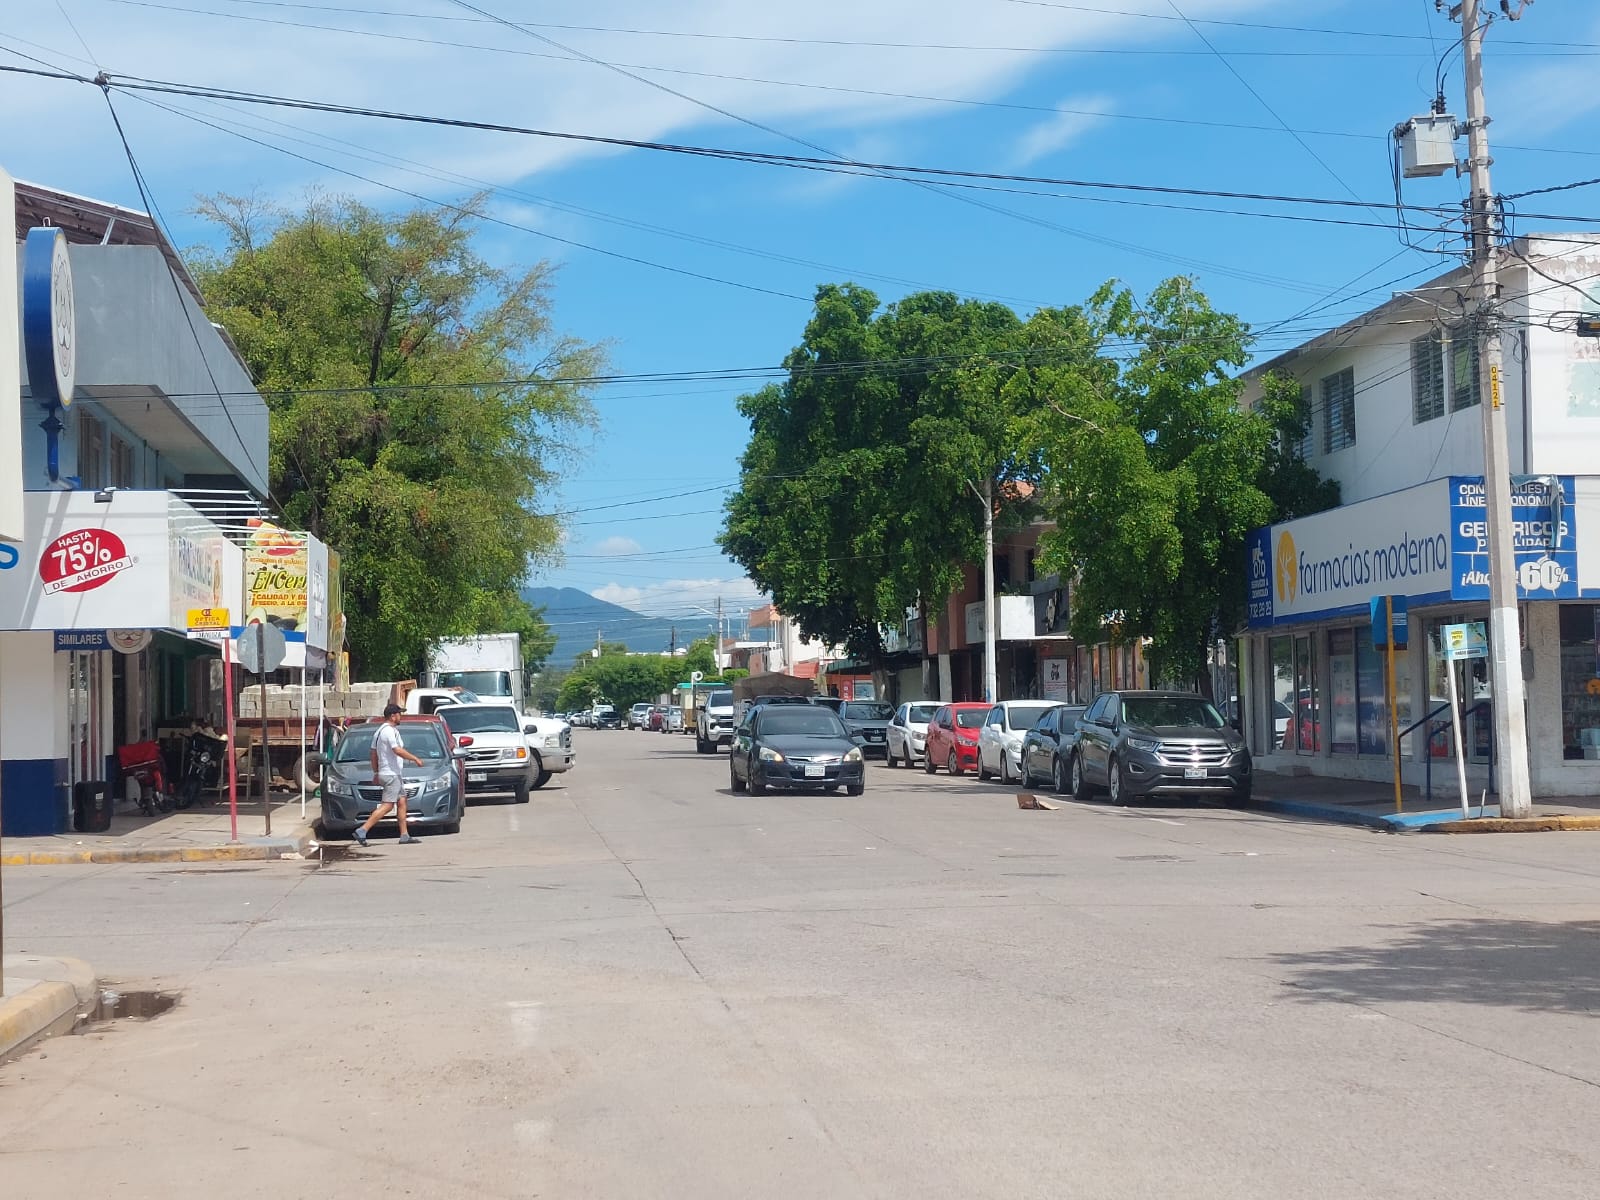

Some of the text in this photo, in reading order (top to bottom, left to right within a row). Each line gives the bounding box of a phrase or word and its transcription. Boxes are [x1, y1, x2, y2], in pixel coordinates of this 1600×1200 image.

[1491, 366, 1501, 408] 04121
[58, 532, 92, 548] HASTA
[51, 537, 112, 576] 75%
[1299, 531, 1447, 596] farmacias moderna
[52, 561, 124, 591] DE AHORRO
[252, 571, 272, 590] El
[1520, 560, 1569, 591] 60%
[58, 634, 103, 645] SIMILARES
